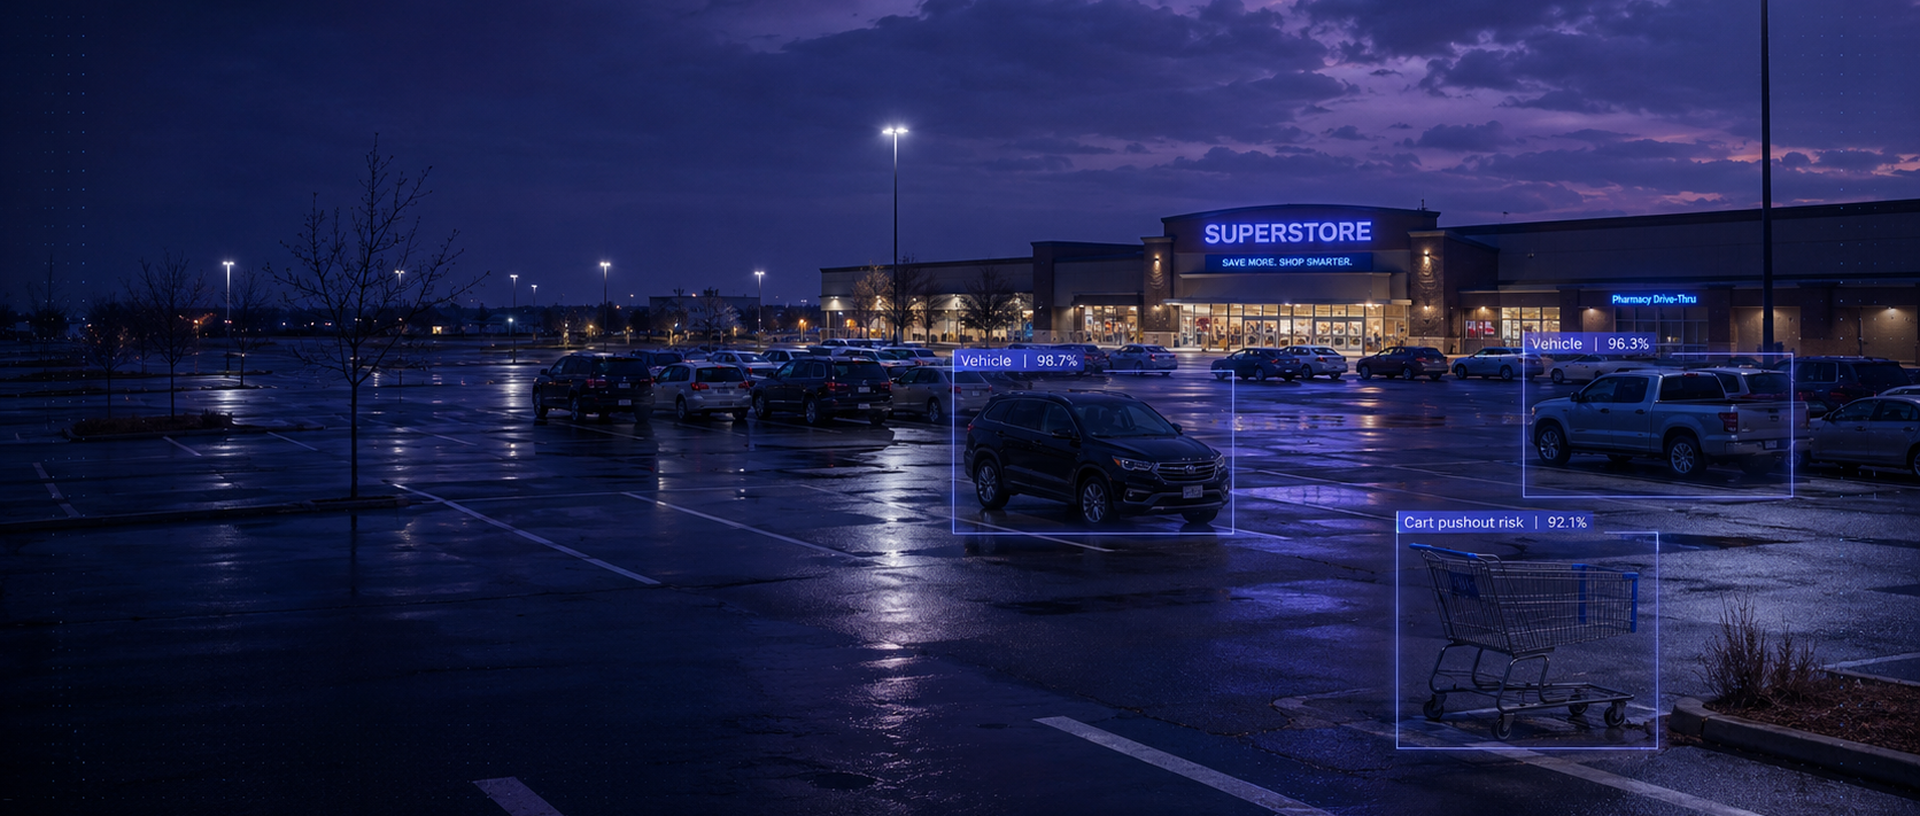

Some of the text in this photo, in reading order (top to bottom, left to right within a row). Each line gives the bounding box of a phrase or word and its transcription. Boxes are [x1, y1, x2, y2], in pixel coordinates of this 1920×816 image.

[1204, 221, 1372, 244] SUPERSTORE
[1222, 257, 1246, 267] SAVE
[1247, 257, 1277, 267] MORE.
[1279, 257, 1305, 267] SHOP
[1611, 293, 1697, 306] Pharmacy Drive-Thru
